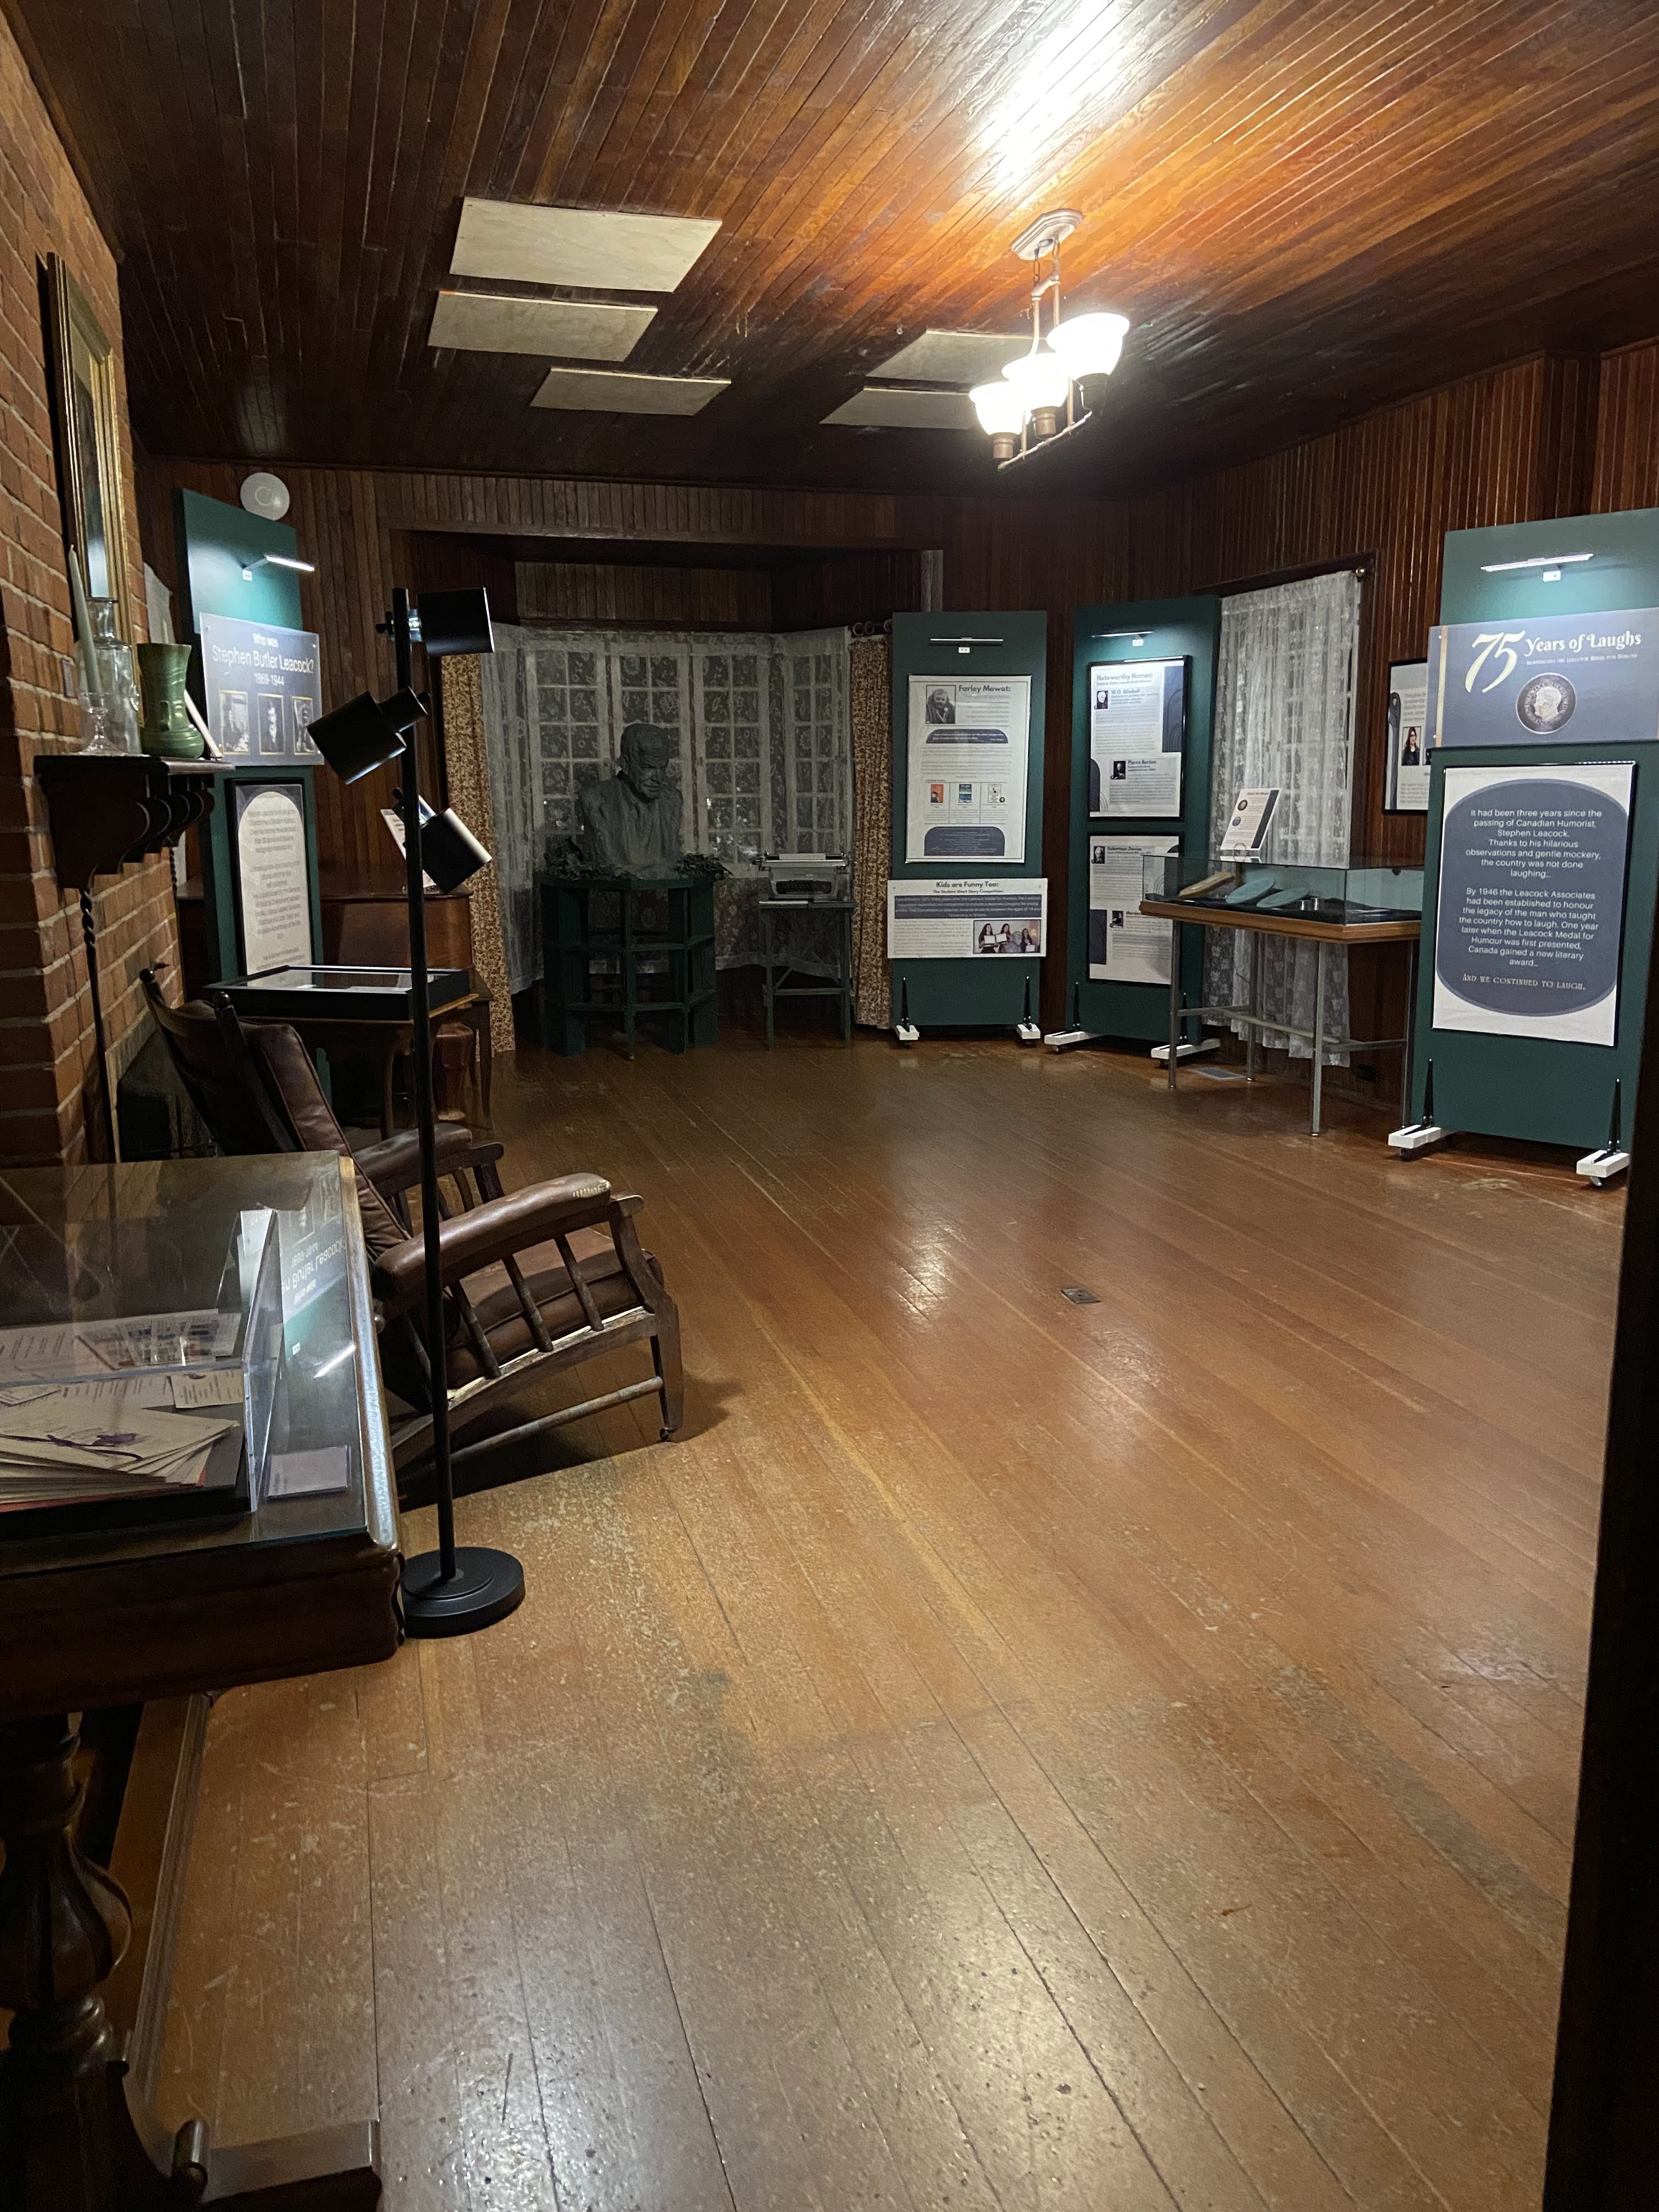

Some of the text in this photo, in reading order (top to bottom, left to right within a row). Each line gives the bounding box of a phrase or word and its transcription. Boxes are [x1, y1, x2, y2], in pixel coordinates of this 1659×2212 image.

[252, 633, 278, 648] Who was
[1524, 630, 1641, 657] Years of Laughs
[212, 645, 314, 674] Stephen Butler Leacock?
[1465, 630, 1526, 692] 75
[959, 685, 981, 693] Farley
[1474, 820, 1504, 828] passing
[1544, 839, 1579, 848] hilarious
[1466, 848, 1515, 857] observations
[1564, 851, 1601, 860] mockery,
[1466, 888, 1476, 896] By
[1550, 891, 1595, 900] Associates
[1564, 901, 1593, 910] honour
[1477, 907, 1503, 916] legacy
[1534, 919, 1558, 929] laugh.
[1561, 921, 1578, 929] One
[1519, 927, 1553, 937] Leacock
[1555, 930, 1580, 939] Medal
[1583, 932, 1594, 940] for
[1471, 936, 1502, 945] Humour
[1522, 938, 1536, 947] first
[1555, 950, 1584, 961] literary
[1493, 977, 1538, 986] CONTINUED
